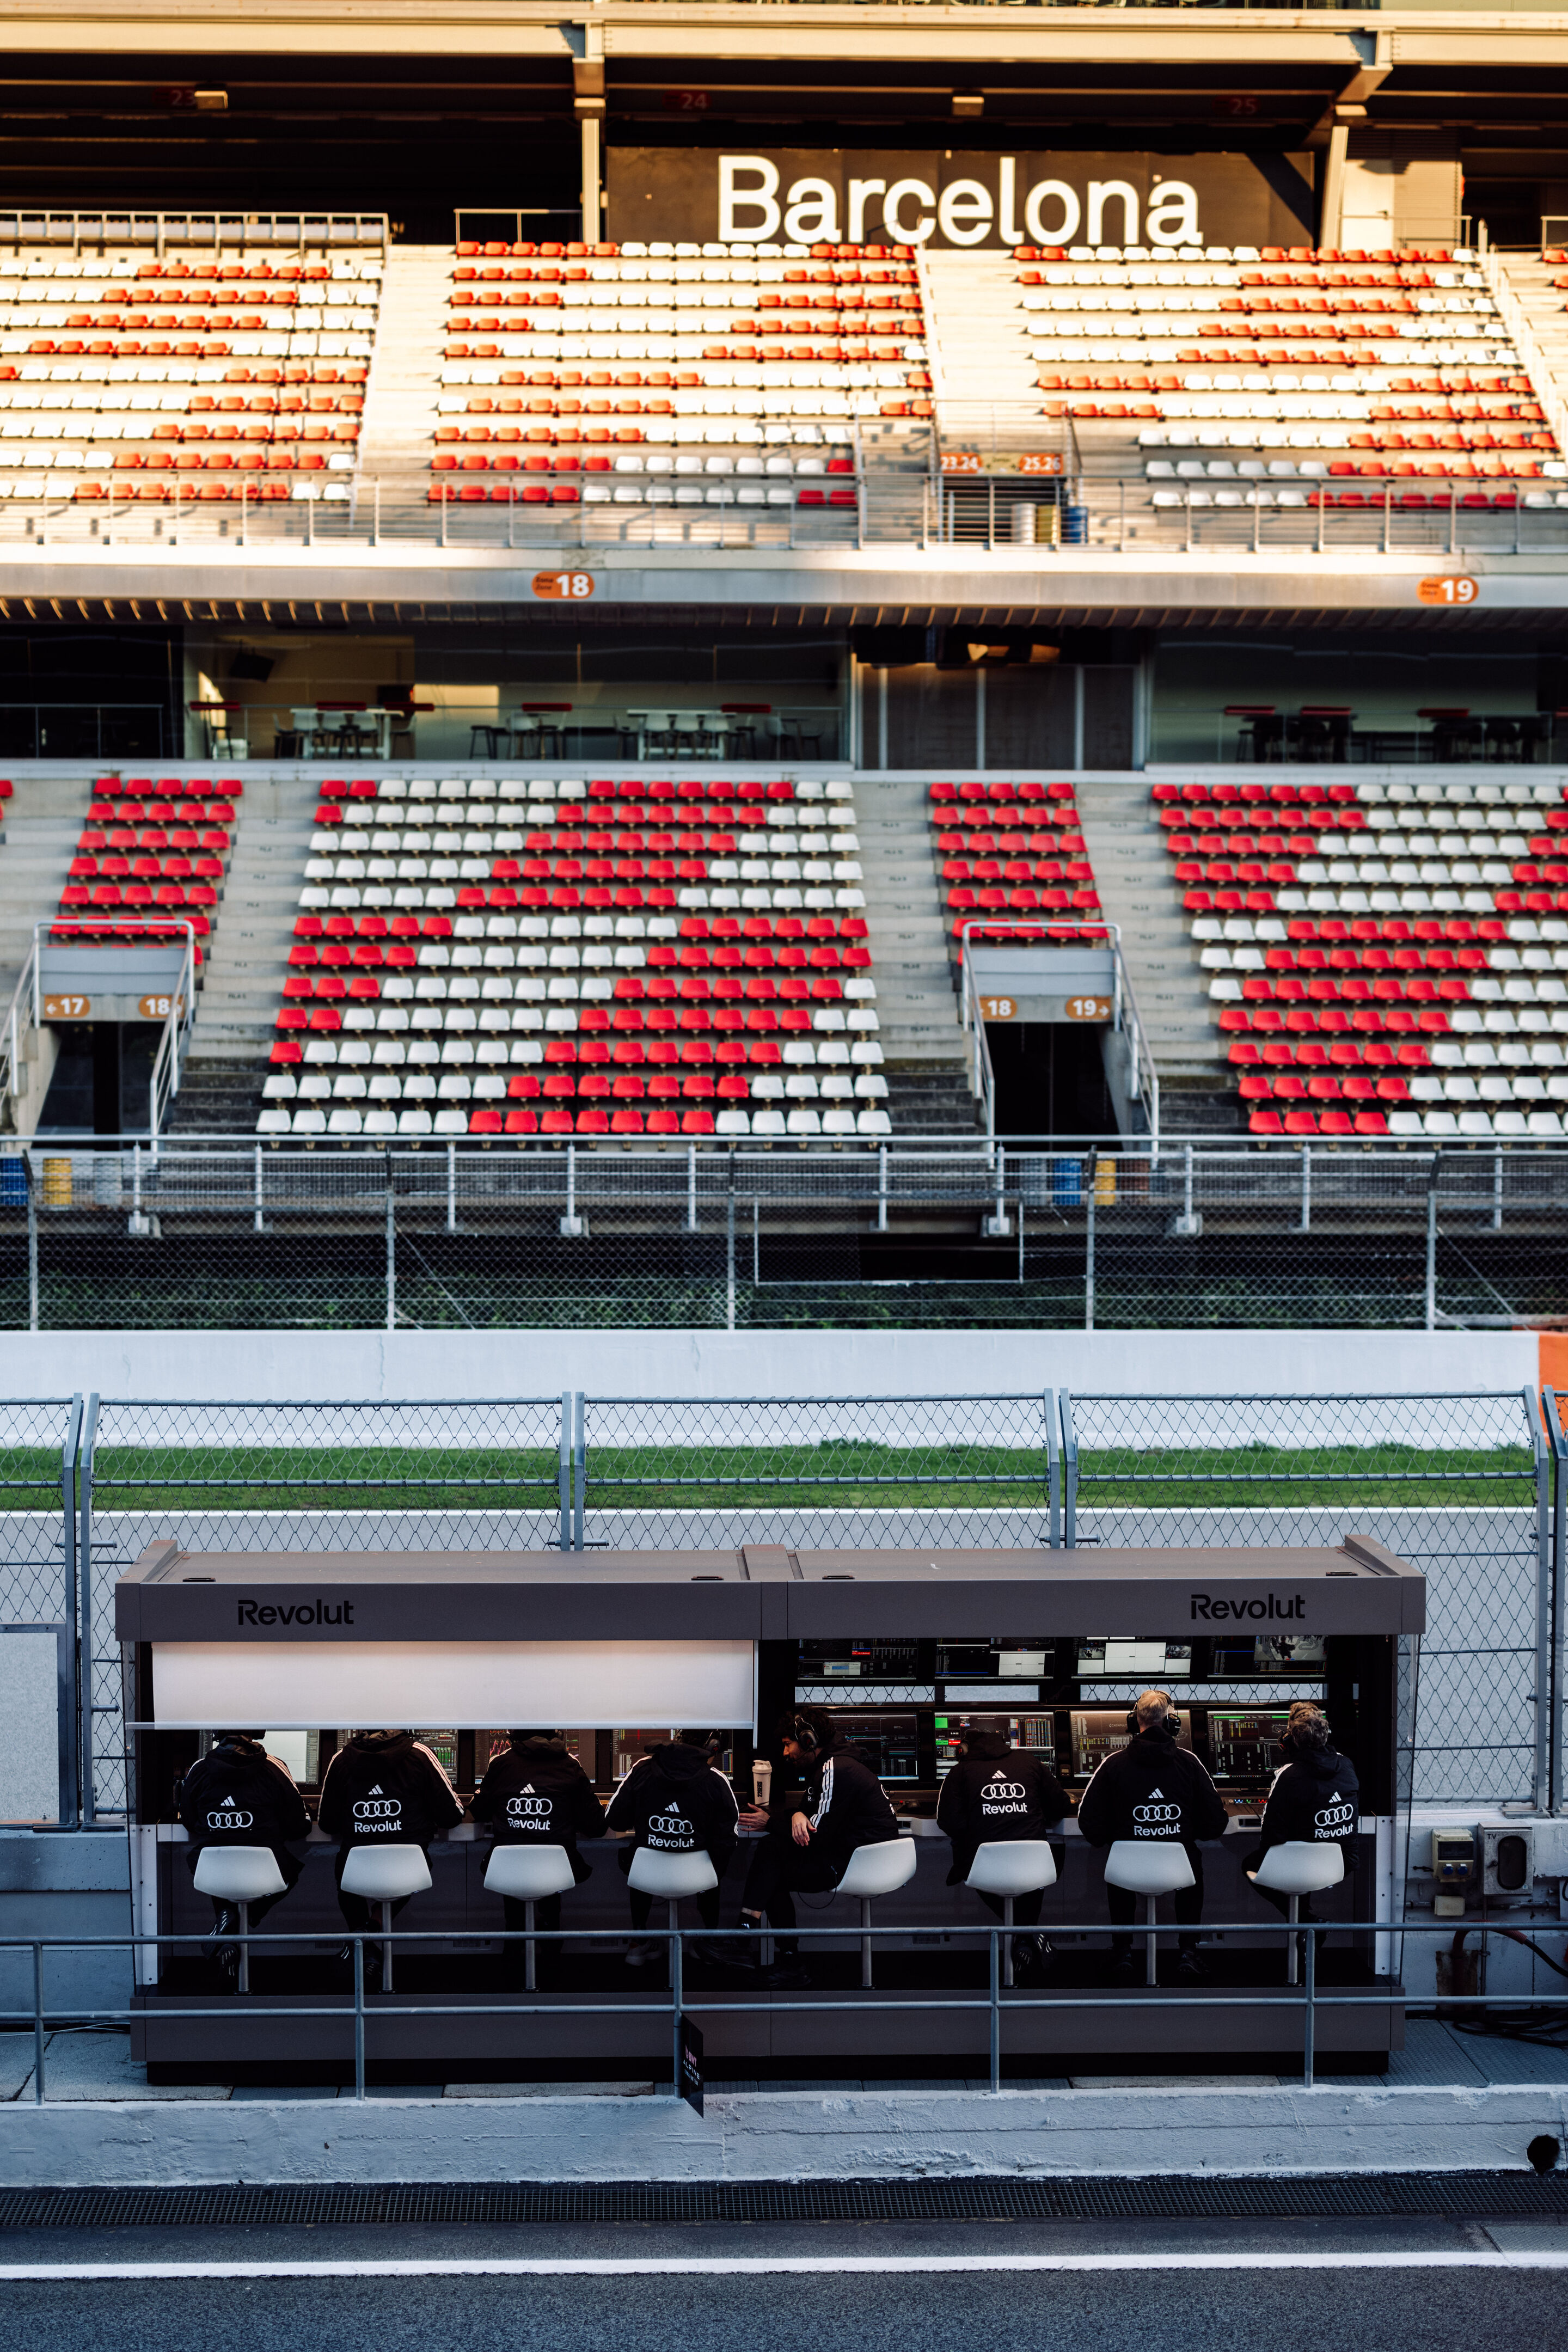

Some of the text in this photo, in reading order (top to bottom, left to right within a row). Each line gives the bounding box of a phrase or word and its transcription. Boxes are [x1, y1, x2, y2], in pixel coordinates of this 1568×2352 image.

[681, 93, 707, 109] 24
[719, 155, 1203, 246] Barcelona
[556, 574, 590, 597] 18
[1441, 579, 1474, 602] 19
[60, 997, 84, 1014] 17
[146, 998, 170, 1015] 18
[988, 1000, 1012, 1016] 18
[1073, 1000, 1097, 1016] 19
[238, 1599, 354, 1625] Revolut
[1191, 1593, 1306, 1620] Revolut
[982, 1802, 1028, 1815] Revolut
[354, 1820, 402, 1833] Revolut
[507, 1817, 550, 1830] Revolut
[1134, 1823, 1181, 1836] Revolut
[1314, 1823, 1353, 1839] Revolut
[648, 1834, 695, 1848] Revolut
[683, 2060, 700, 2080] ALPINE
